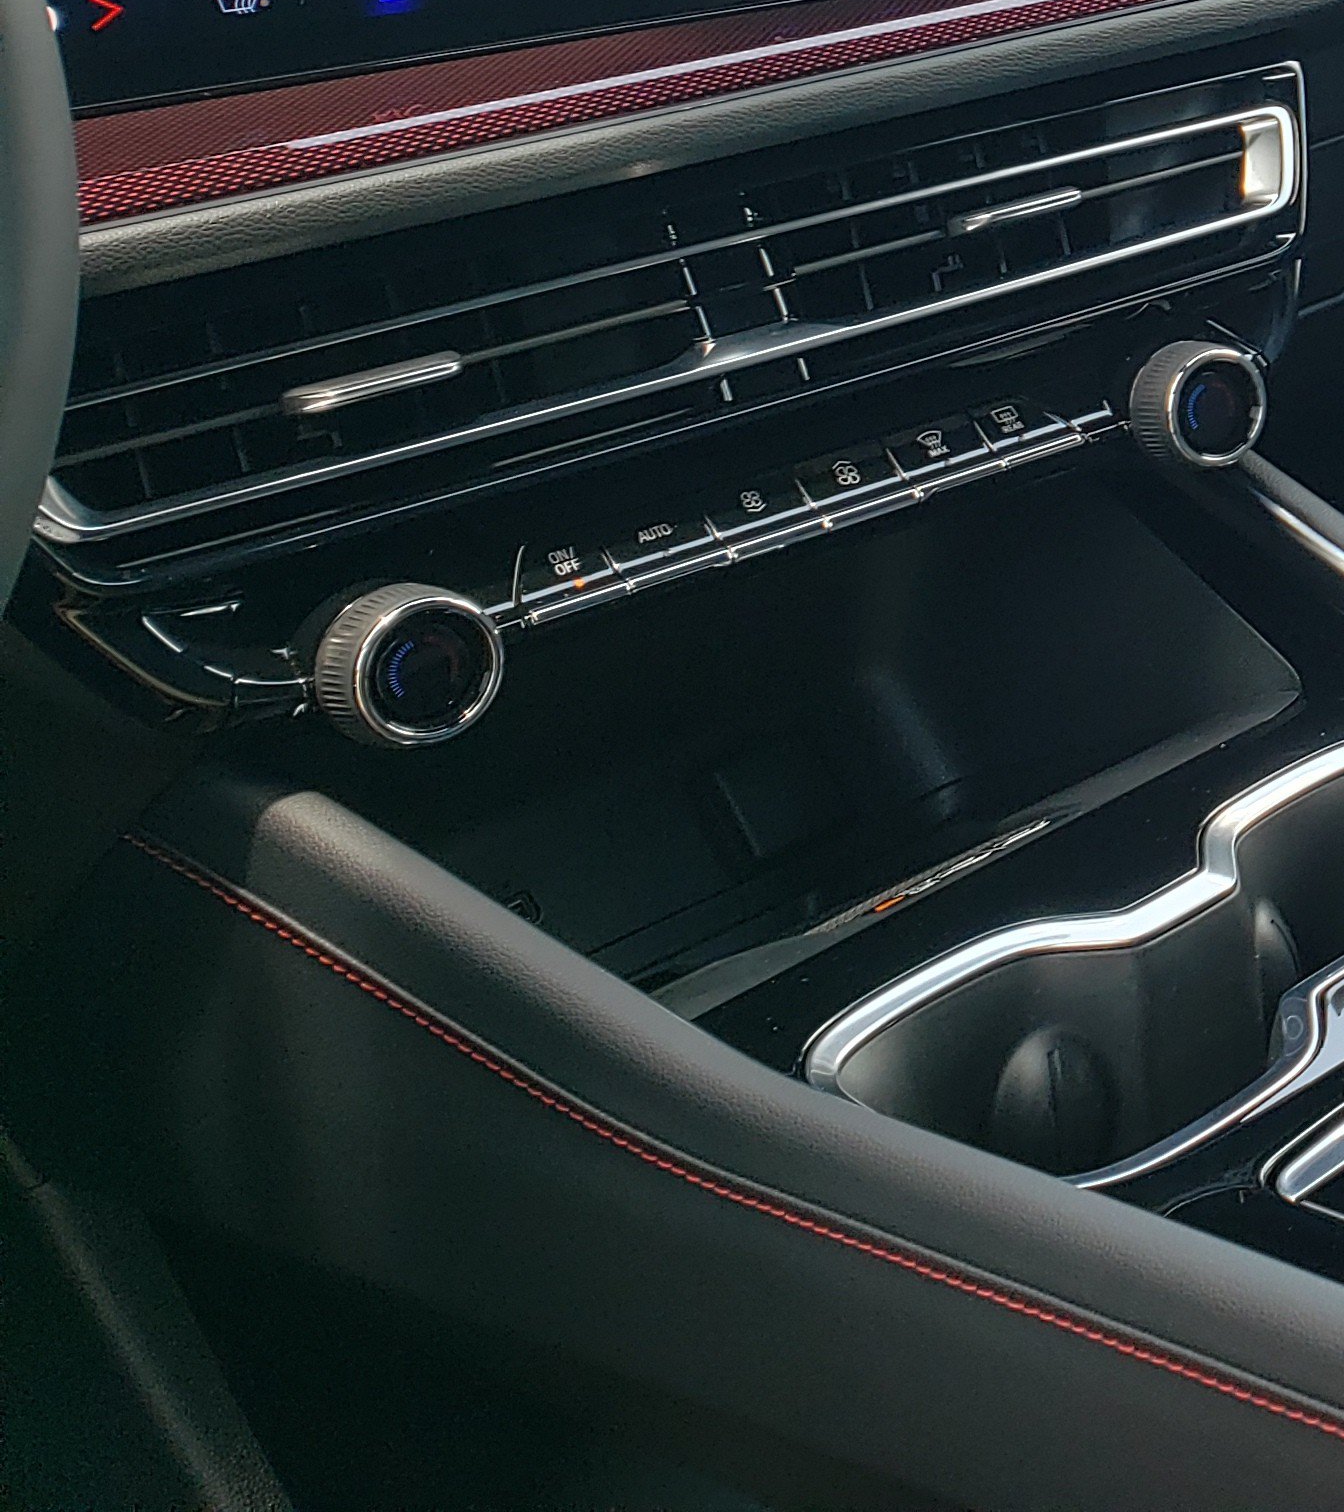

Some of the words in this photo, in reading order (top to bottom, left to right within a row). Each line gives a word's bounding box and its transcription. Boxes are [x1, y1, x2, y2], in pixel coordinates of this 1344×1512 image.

[637, 522, 674, 544] AUTO
[547, 545, 575, 565] ON/
[554, 557, 581, 576] OFF
